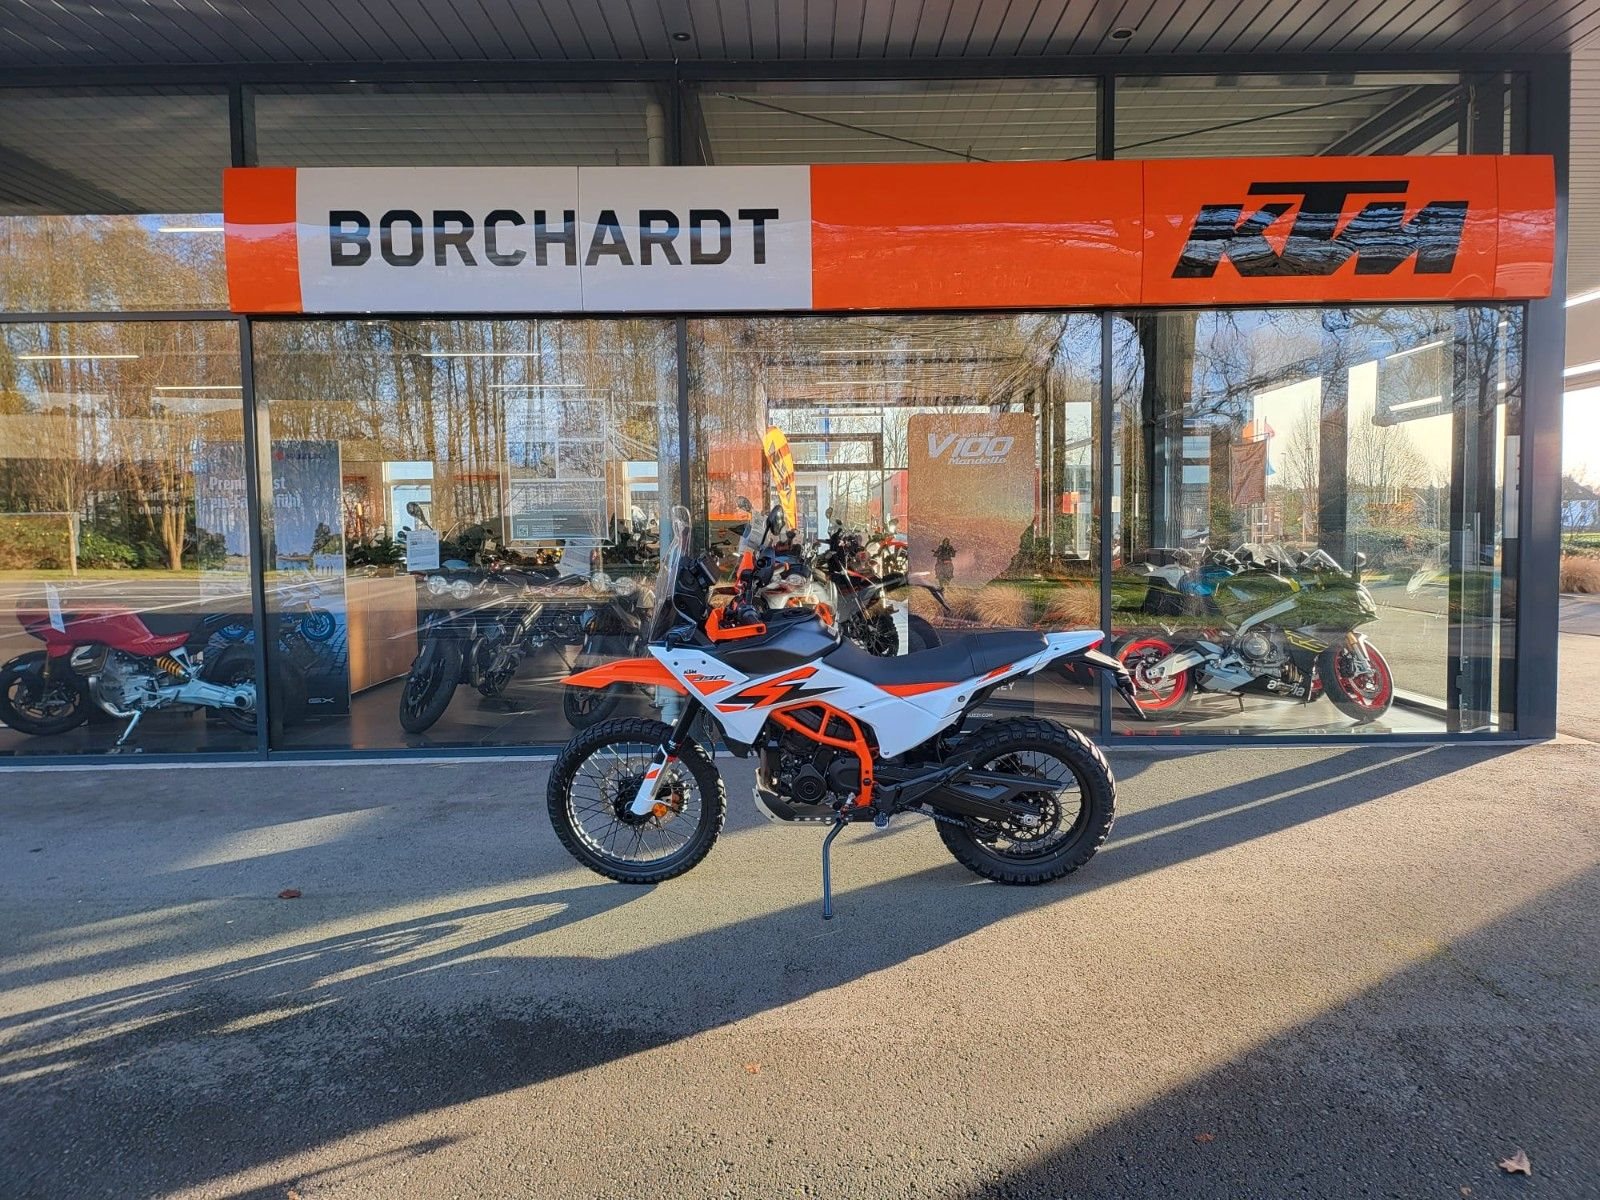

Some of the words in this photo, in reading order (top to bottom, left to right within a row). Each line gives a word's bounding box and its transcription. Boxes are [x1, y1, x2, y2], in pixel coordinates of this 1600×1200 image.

[1171, 180, 1469, 279] KTM
[328, 208, 779, 267] BORCHARDT
[927, 432, 1015, 458] V100
[948, 456, 1007, 465] Mandello
[209, 475, 248, 490] Premi
[138, 503, 163, 515] ohne
[693, 674, 726, 682] 390
